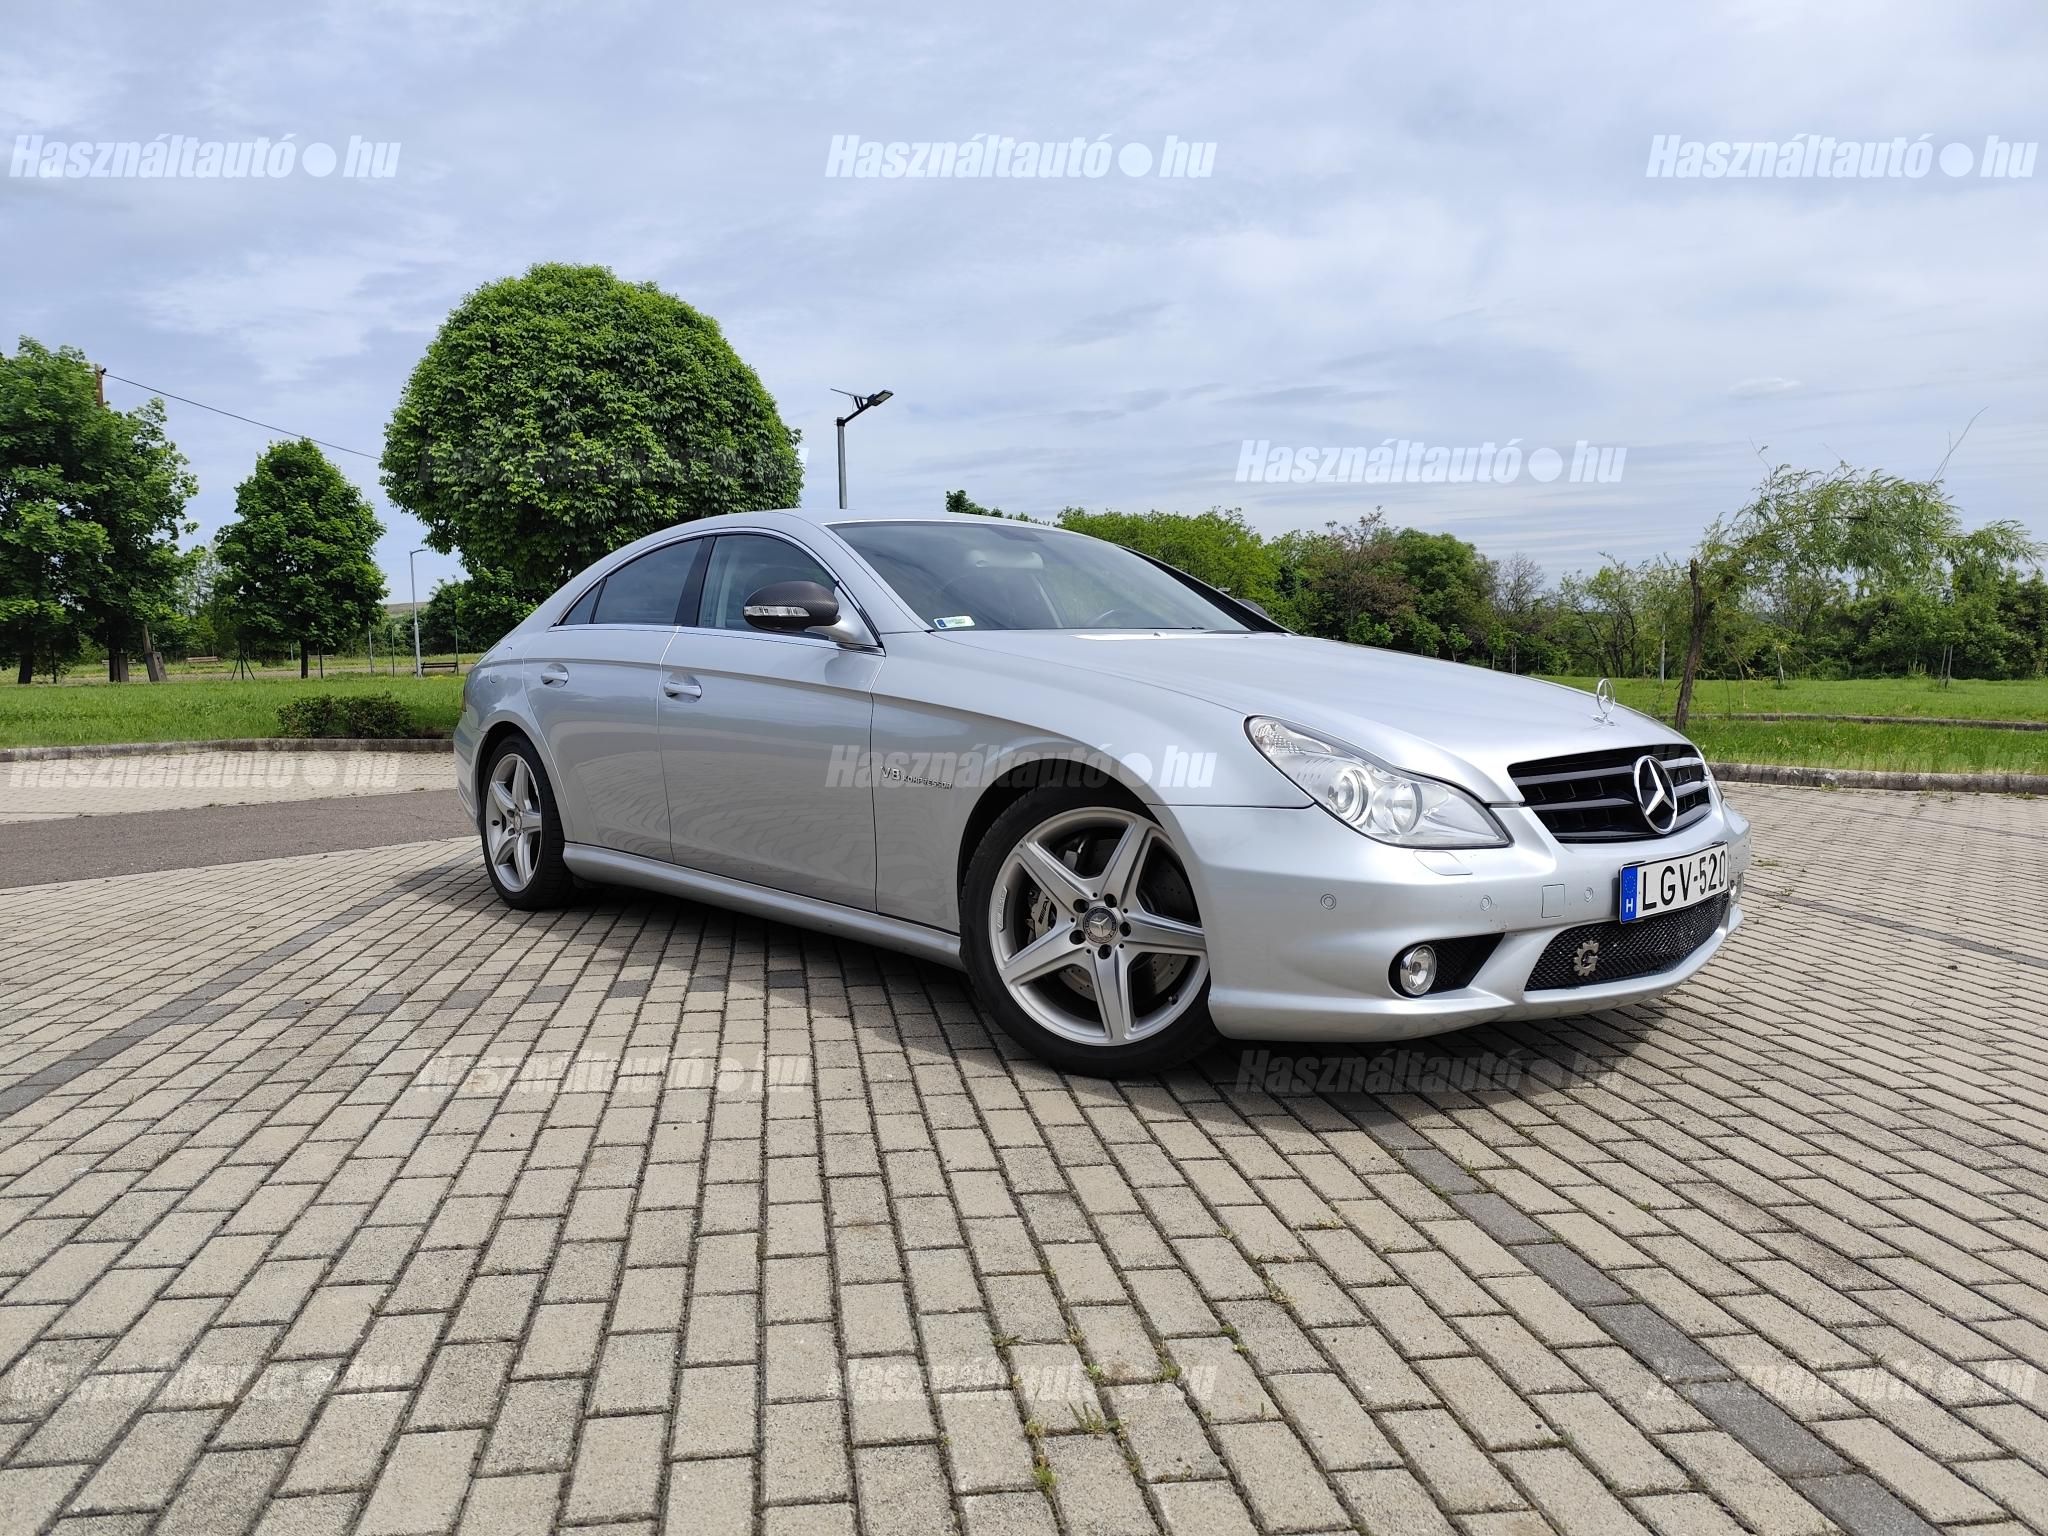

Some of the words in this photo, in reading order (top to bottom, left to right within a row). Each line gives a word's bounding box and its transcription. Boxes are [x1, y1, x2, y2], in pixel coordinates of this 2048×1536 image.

[880, 766, 900, 780] V8
[1642, 850, 1726, 911] LGV-520
[1625, 898, 1634, 913] H
